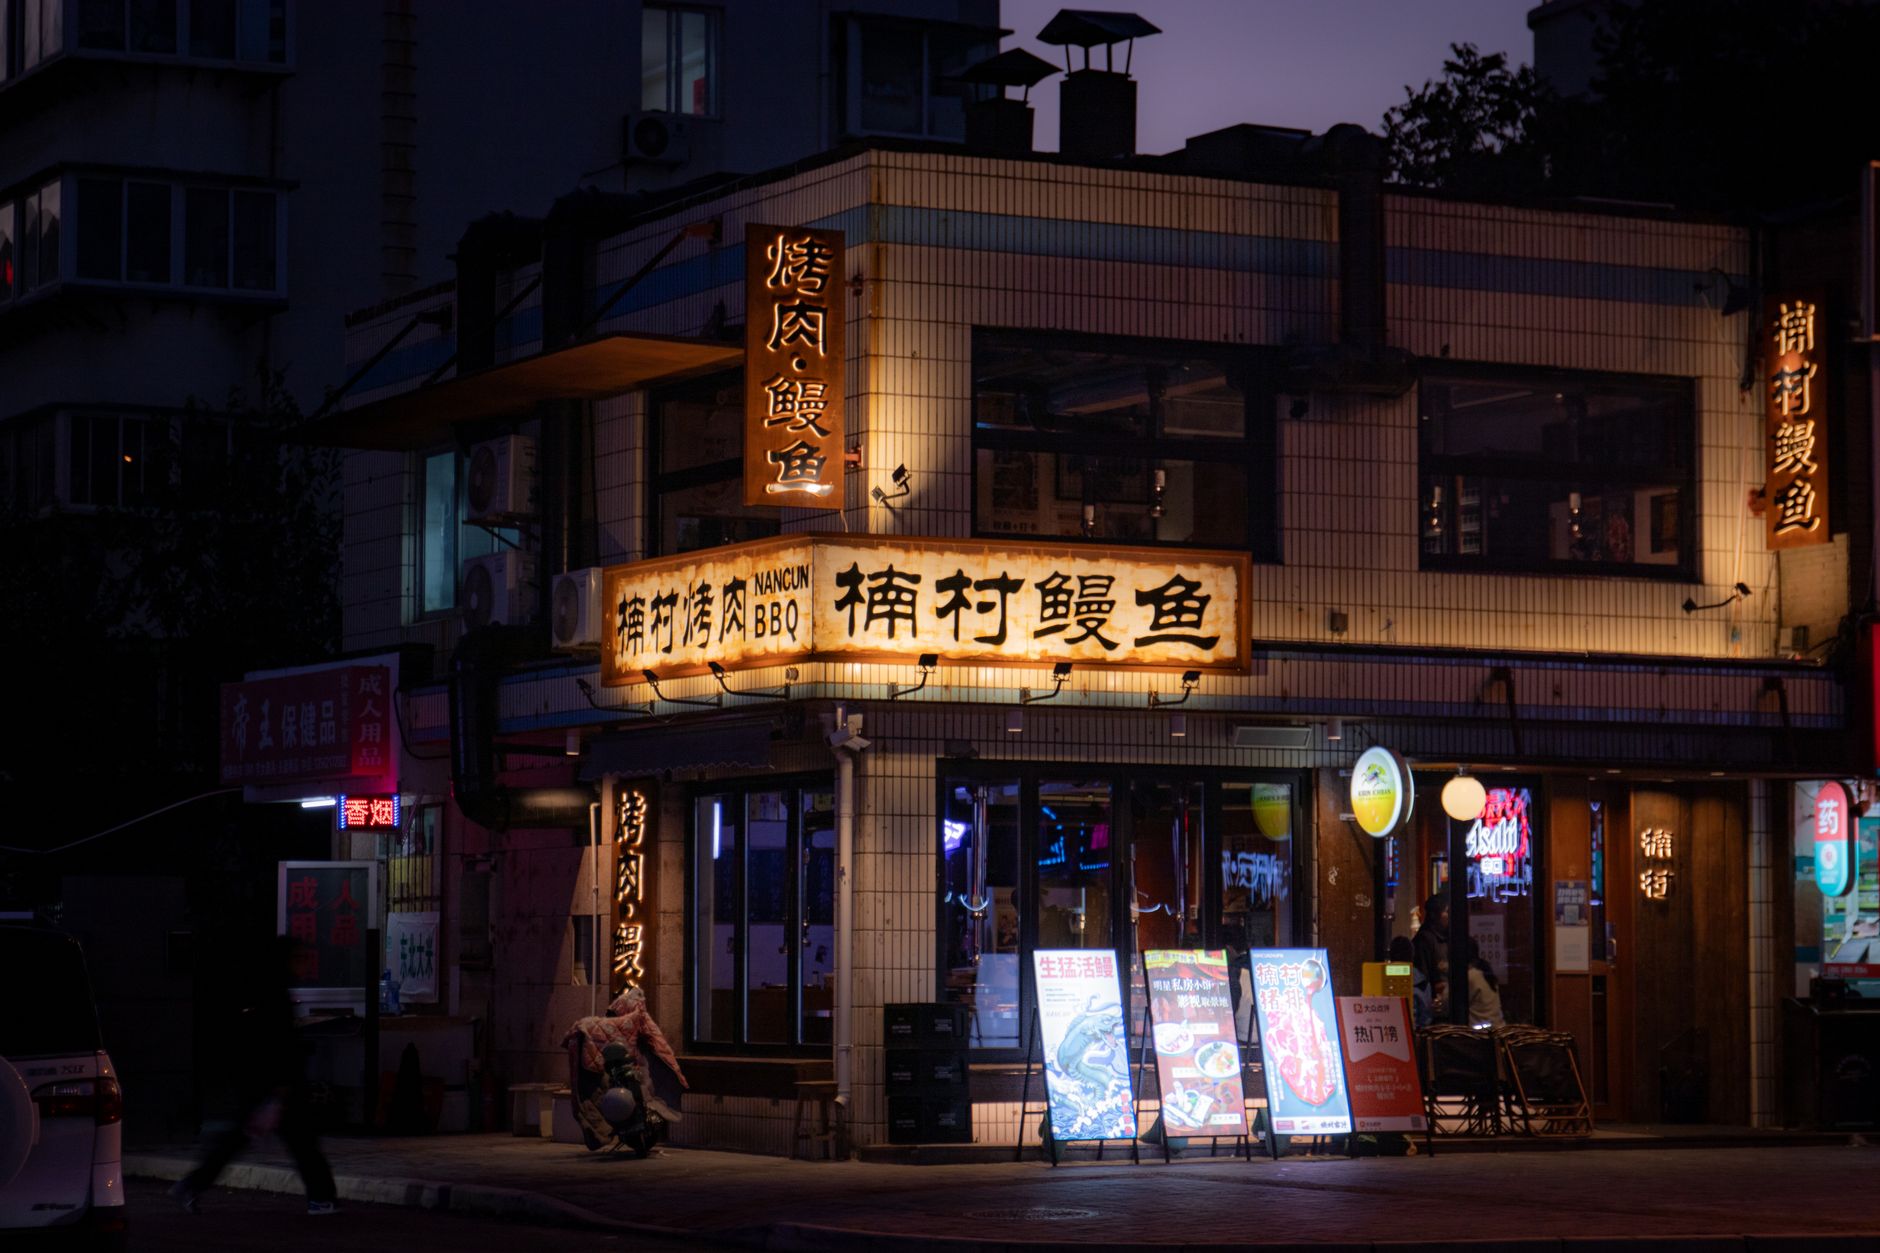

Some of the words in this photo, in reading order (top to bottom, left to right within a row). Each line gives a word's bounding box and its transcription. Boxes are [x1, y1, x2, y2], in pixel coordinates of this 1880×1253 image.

[1772, 299, 1821, 536] 楠村鳗鱼
[754, 563, 811, 597] NANCUN
[617, 574, 749, 657] 楠村烤肉
[754, 602, 800, 642] BBQ
[834, 561, 1221, 652] 楠村鳗鱼
[231, 691, 337, 753] 帝王保健品
[357, 673, 383, 767] 成人用品
[344, 798, 394, 826] 香烟
[1818, 799, 1839, 836] 药
[1465, 816, 1518, 857] Asahi
[1640, 827, 1675, 901] 楠村
[1039, 956, 1115, 979] 生猛活鳗
[1256, 963, 1301, 985] 楠村
[1259, 988, 1303, 1010] 猪排
[1354, 1025, 1399, 1043] 热门榜
